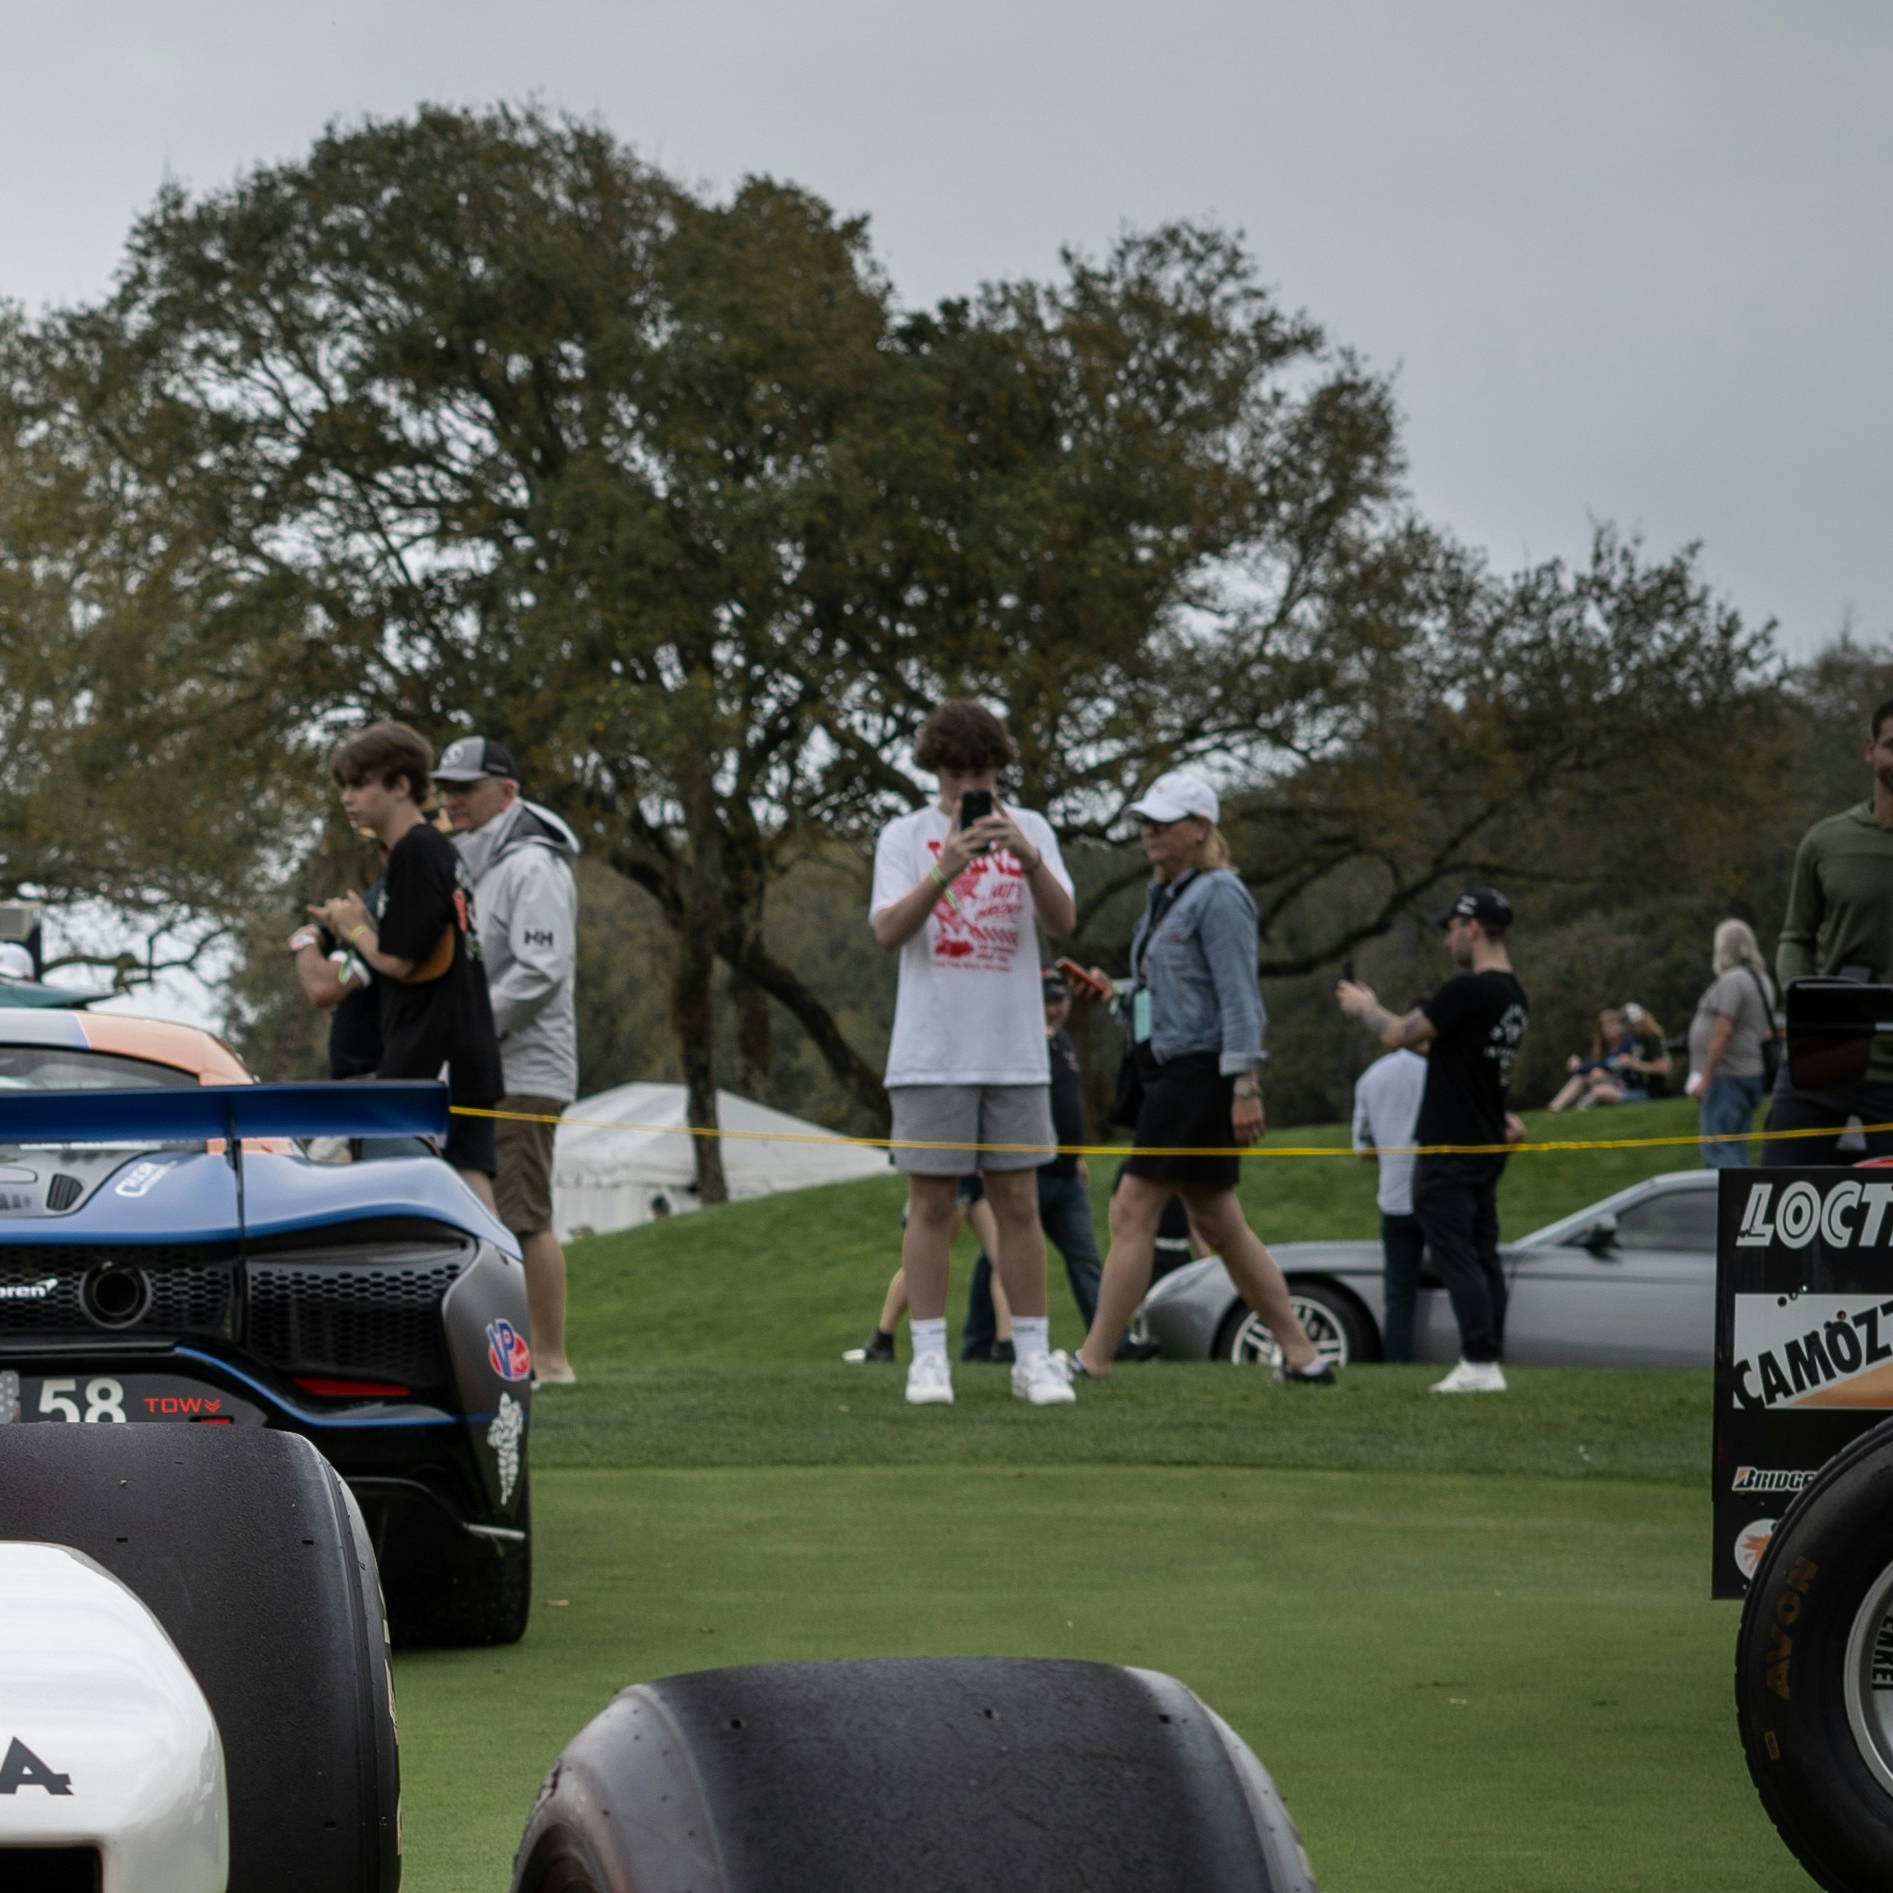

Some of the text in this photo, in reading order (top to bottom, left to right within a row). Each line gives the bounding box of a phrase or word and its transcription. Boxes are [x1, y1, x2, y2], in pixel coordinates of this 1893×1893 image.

[1735, 1180, 1893, 1250] LOCT
[1732, 1300, 1893, 1409] CAMOZ
[38, 1378, 127, 1423] 58
[144, 1398, 203, 1414] TOW
[1766, 1555, 1819, 1702] AVON
